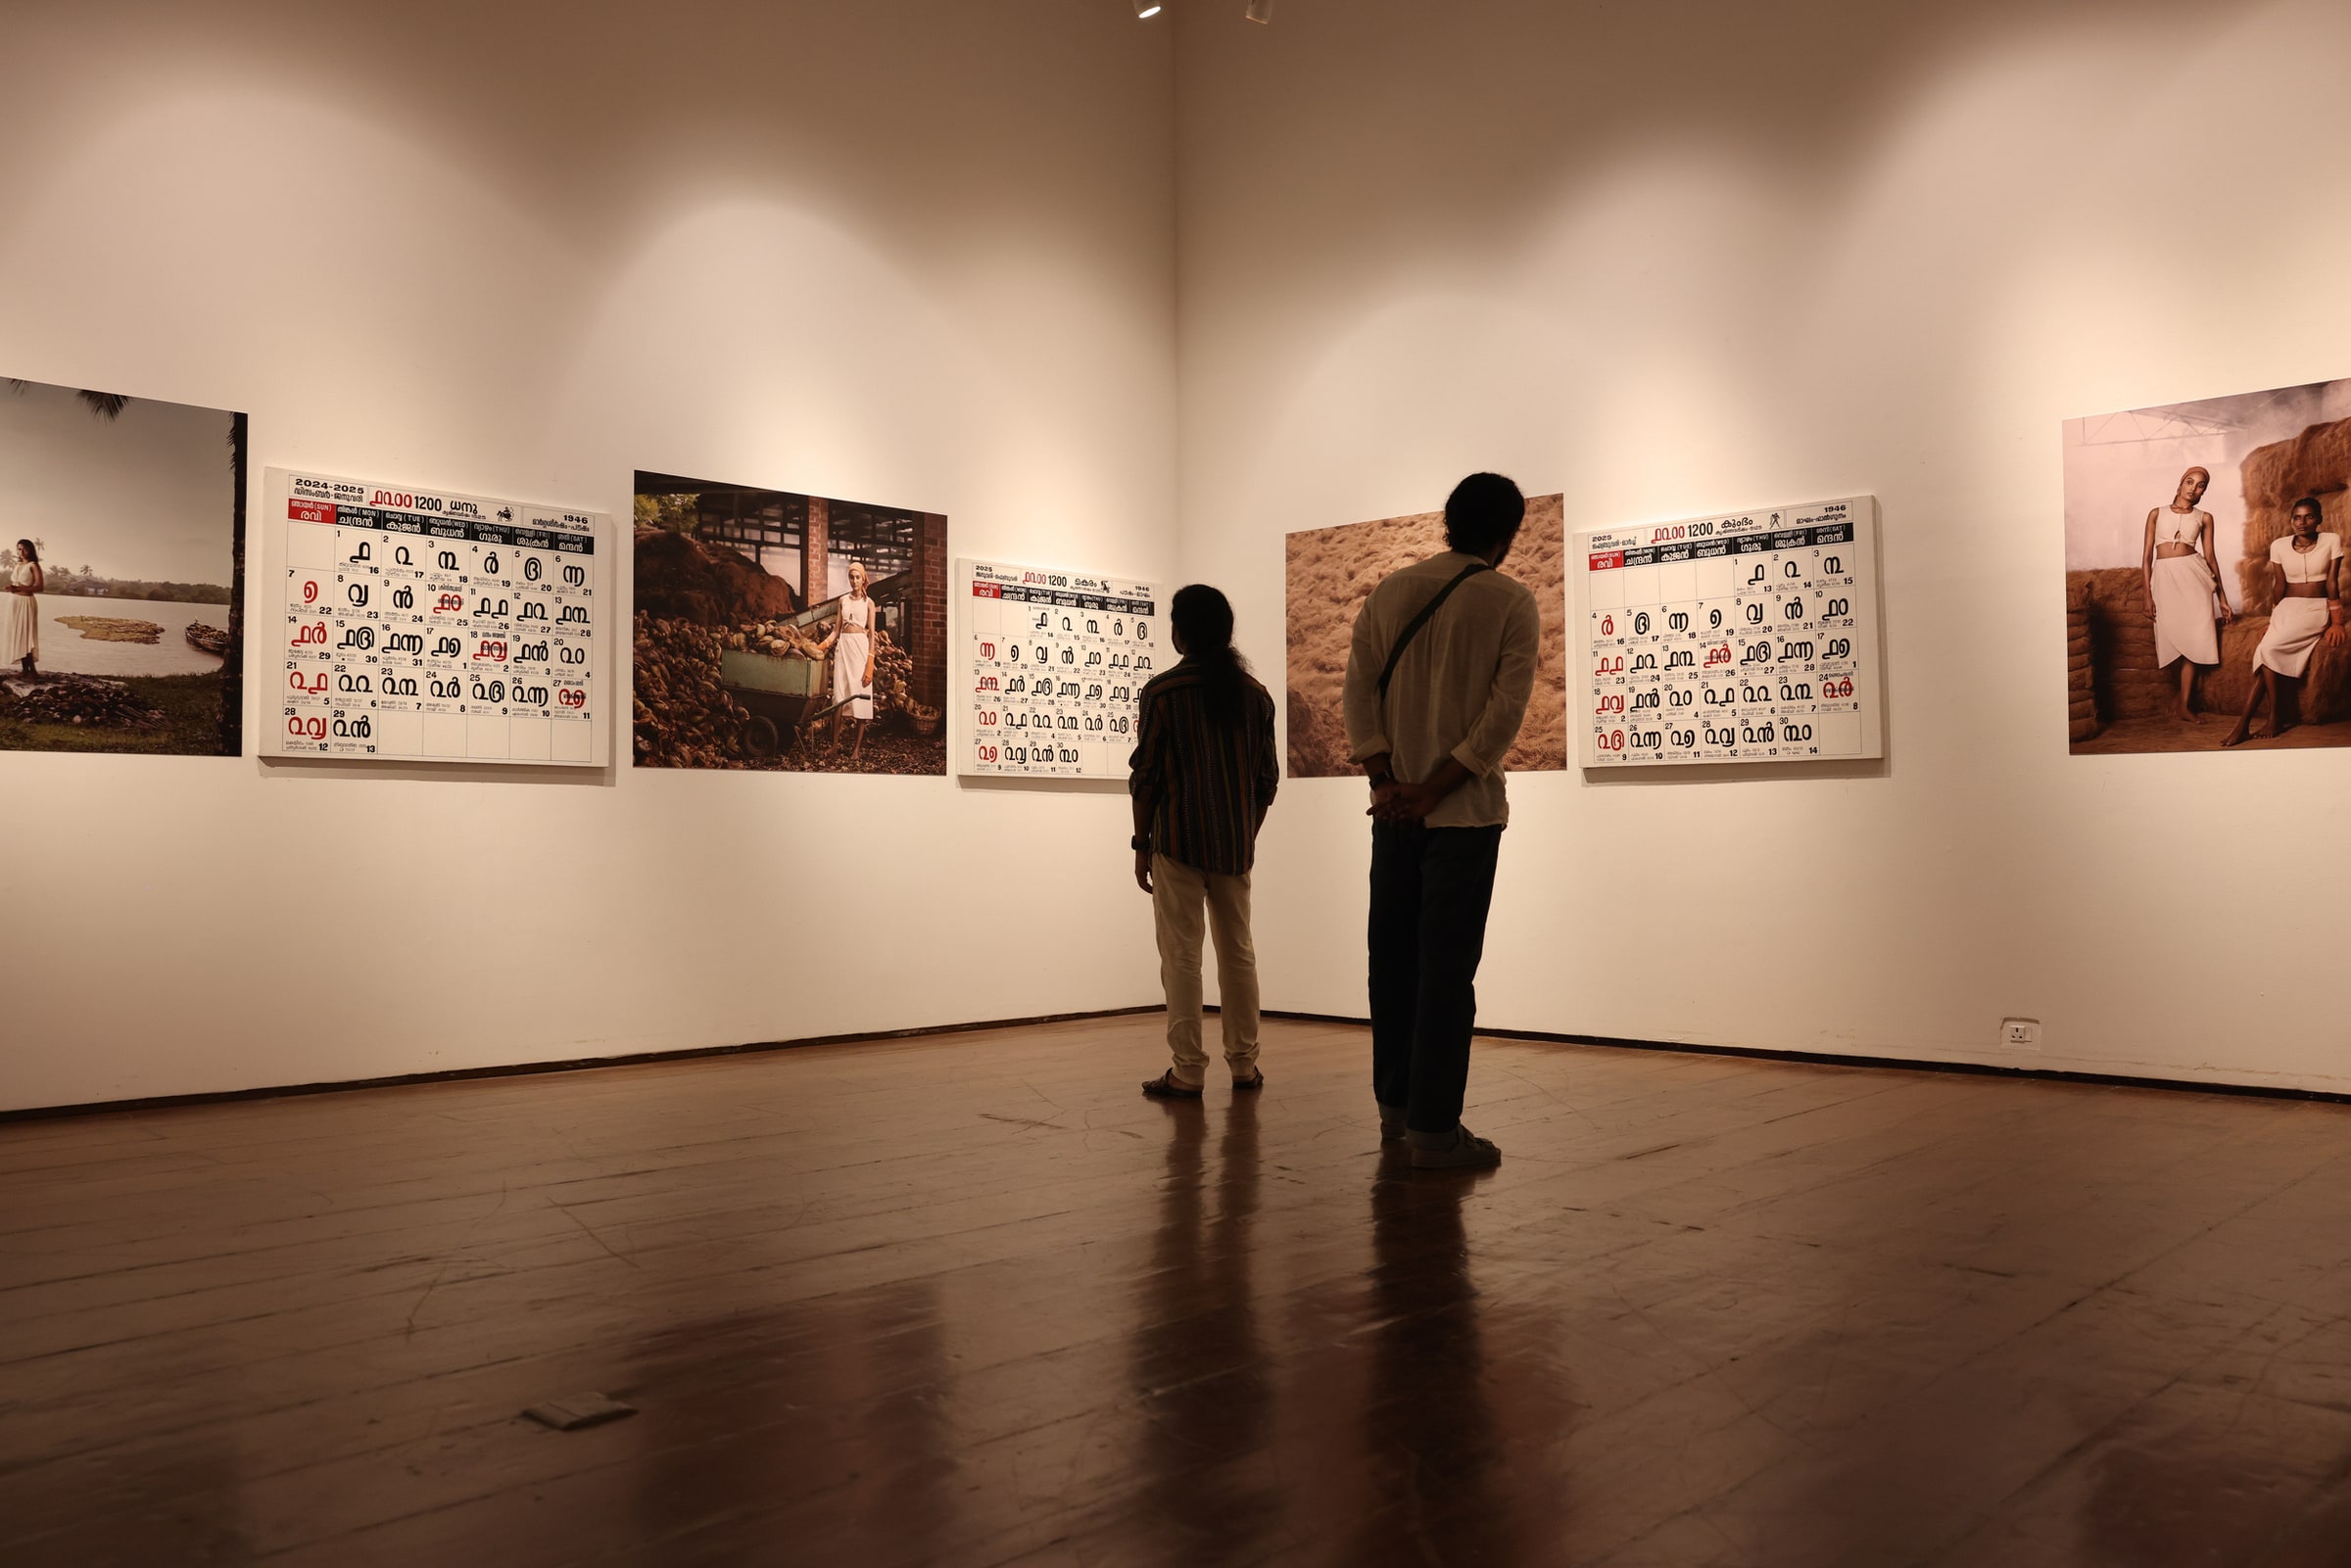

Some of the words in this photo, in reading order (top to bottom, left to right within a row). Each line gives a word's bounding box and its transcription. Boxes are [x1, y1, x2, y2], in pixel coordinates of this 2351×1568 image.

[295, 478, 364, 494] 2024-2025
[414, 496, 442, 511] 1200
[451, 499, 478, 514] ധനു
[1824, 504, 1847, 513] 1946
[563, 514, 588, 524] 1946
[1688, 522, 1713, 538] 1200
[1048, 575, 1067, 588] 1200
